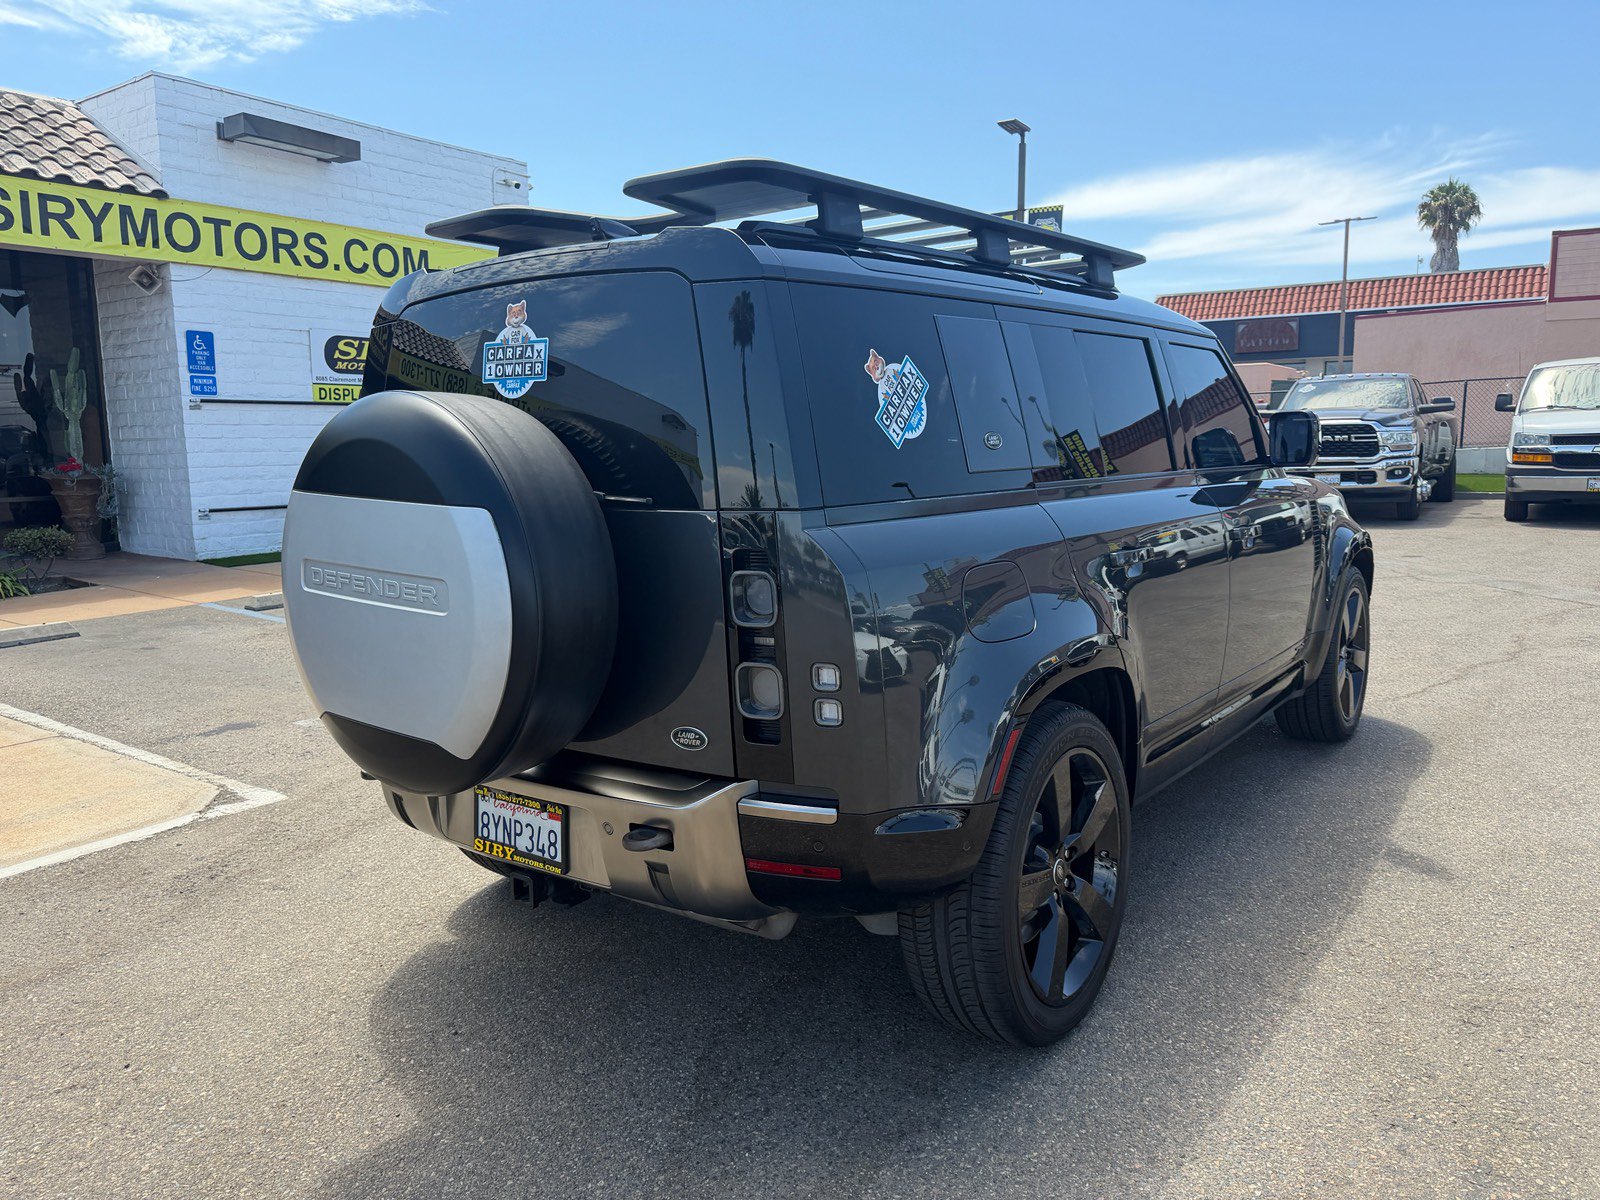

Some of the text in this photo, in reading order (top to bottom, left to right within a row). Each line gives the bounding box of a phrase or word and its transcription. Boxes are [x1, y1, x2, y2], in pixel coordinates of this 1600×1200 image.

[334, 339, 370, 360] SI
[488, 346, 543, 360] CARFAX
[335, 361, 366, 371] MOT
[318, 387, 361, 401] DISPL
[882, 367, 916, 426] CARFAX
[311, 566, 439, 605] DEFENDER
[678, 731, 695, 739] LAND
[680, 738, 701, 746] ROVER
[480, 811, 558, 860] 8YNP348
